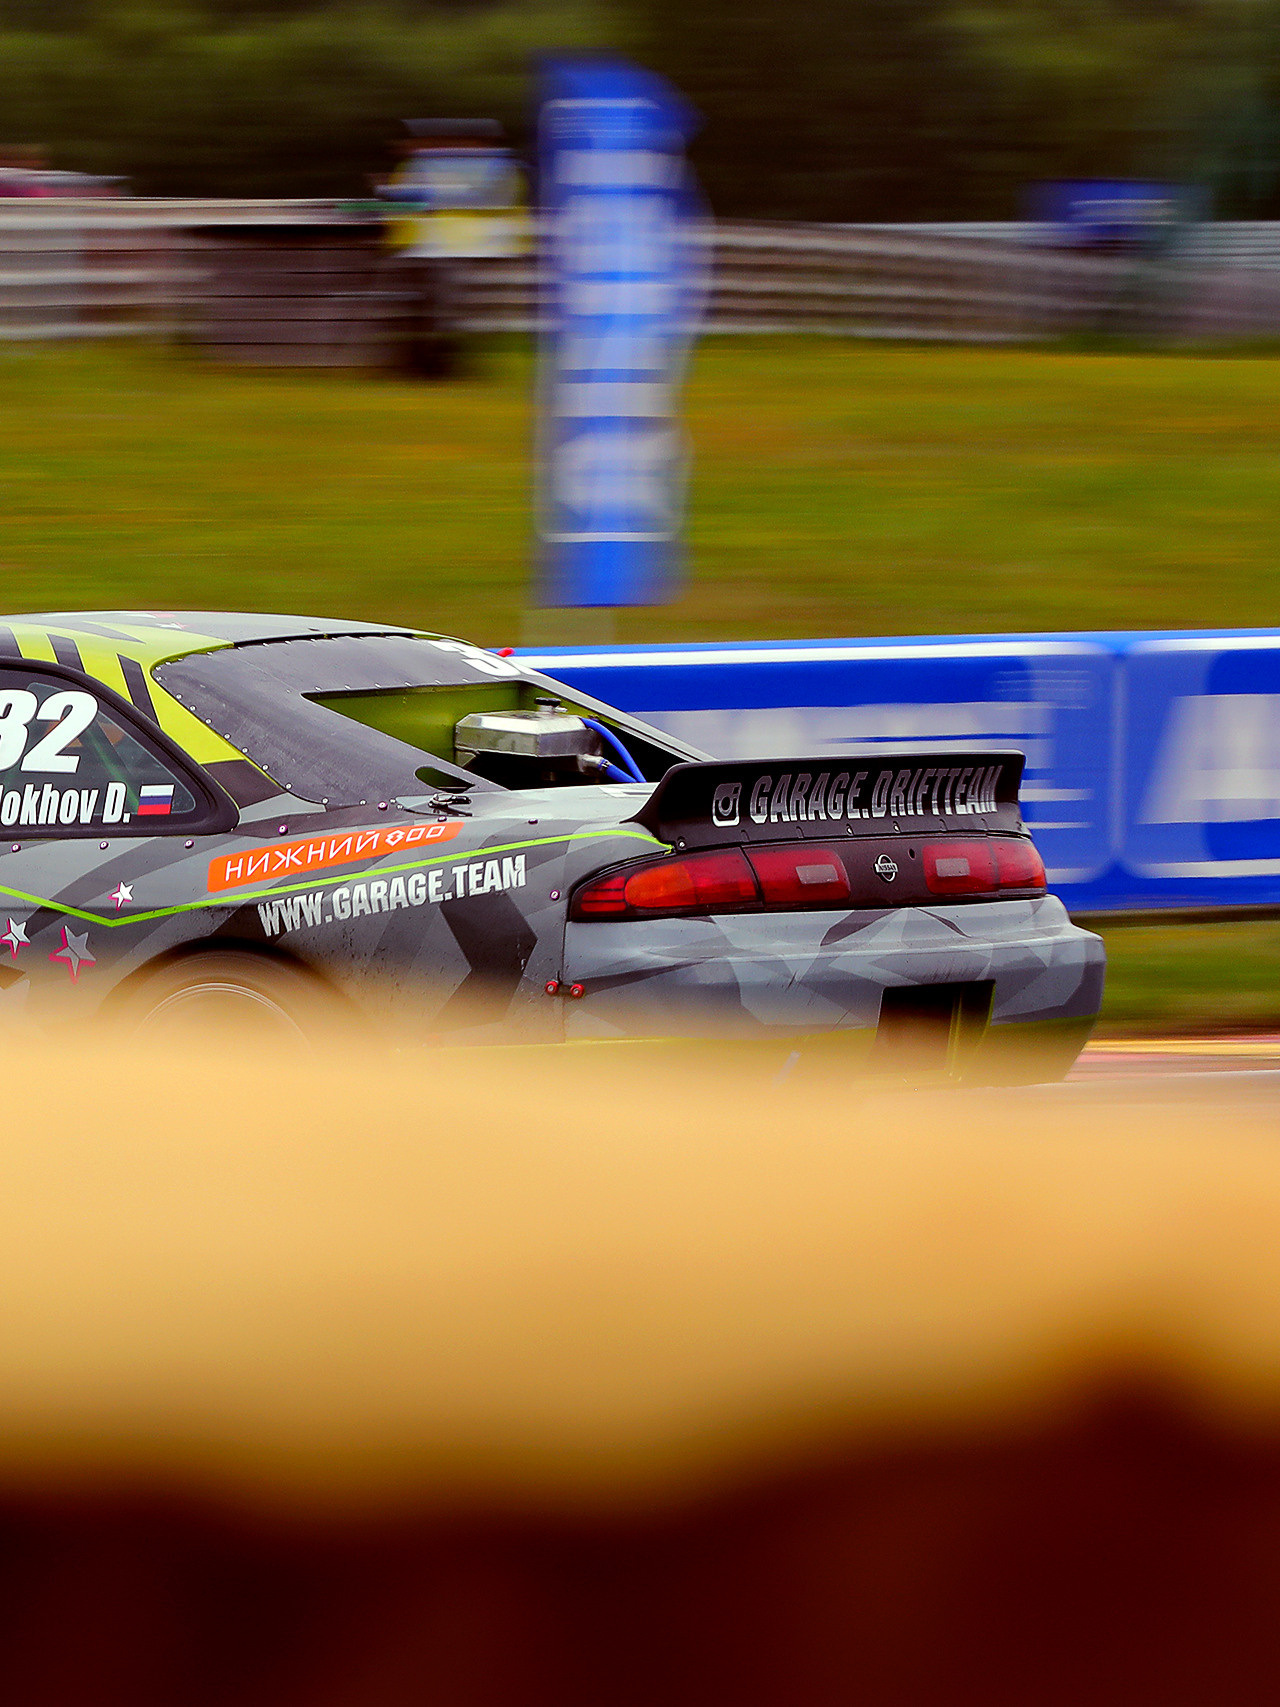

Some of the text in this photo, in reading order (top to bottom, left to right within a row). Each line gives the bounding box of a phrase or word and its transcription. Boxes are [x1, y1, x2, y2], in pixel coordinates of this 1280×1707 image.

[102, 781, 131, 825] D.
[749, 764, 1004, 825] GARAGE.DRIFTTEAM
[224, 830, 381, 882] НИЖНИЙ
[257, 853, 528, 938] WWW.GARAGE.TEAM
